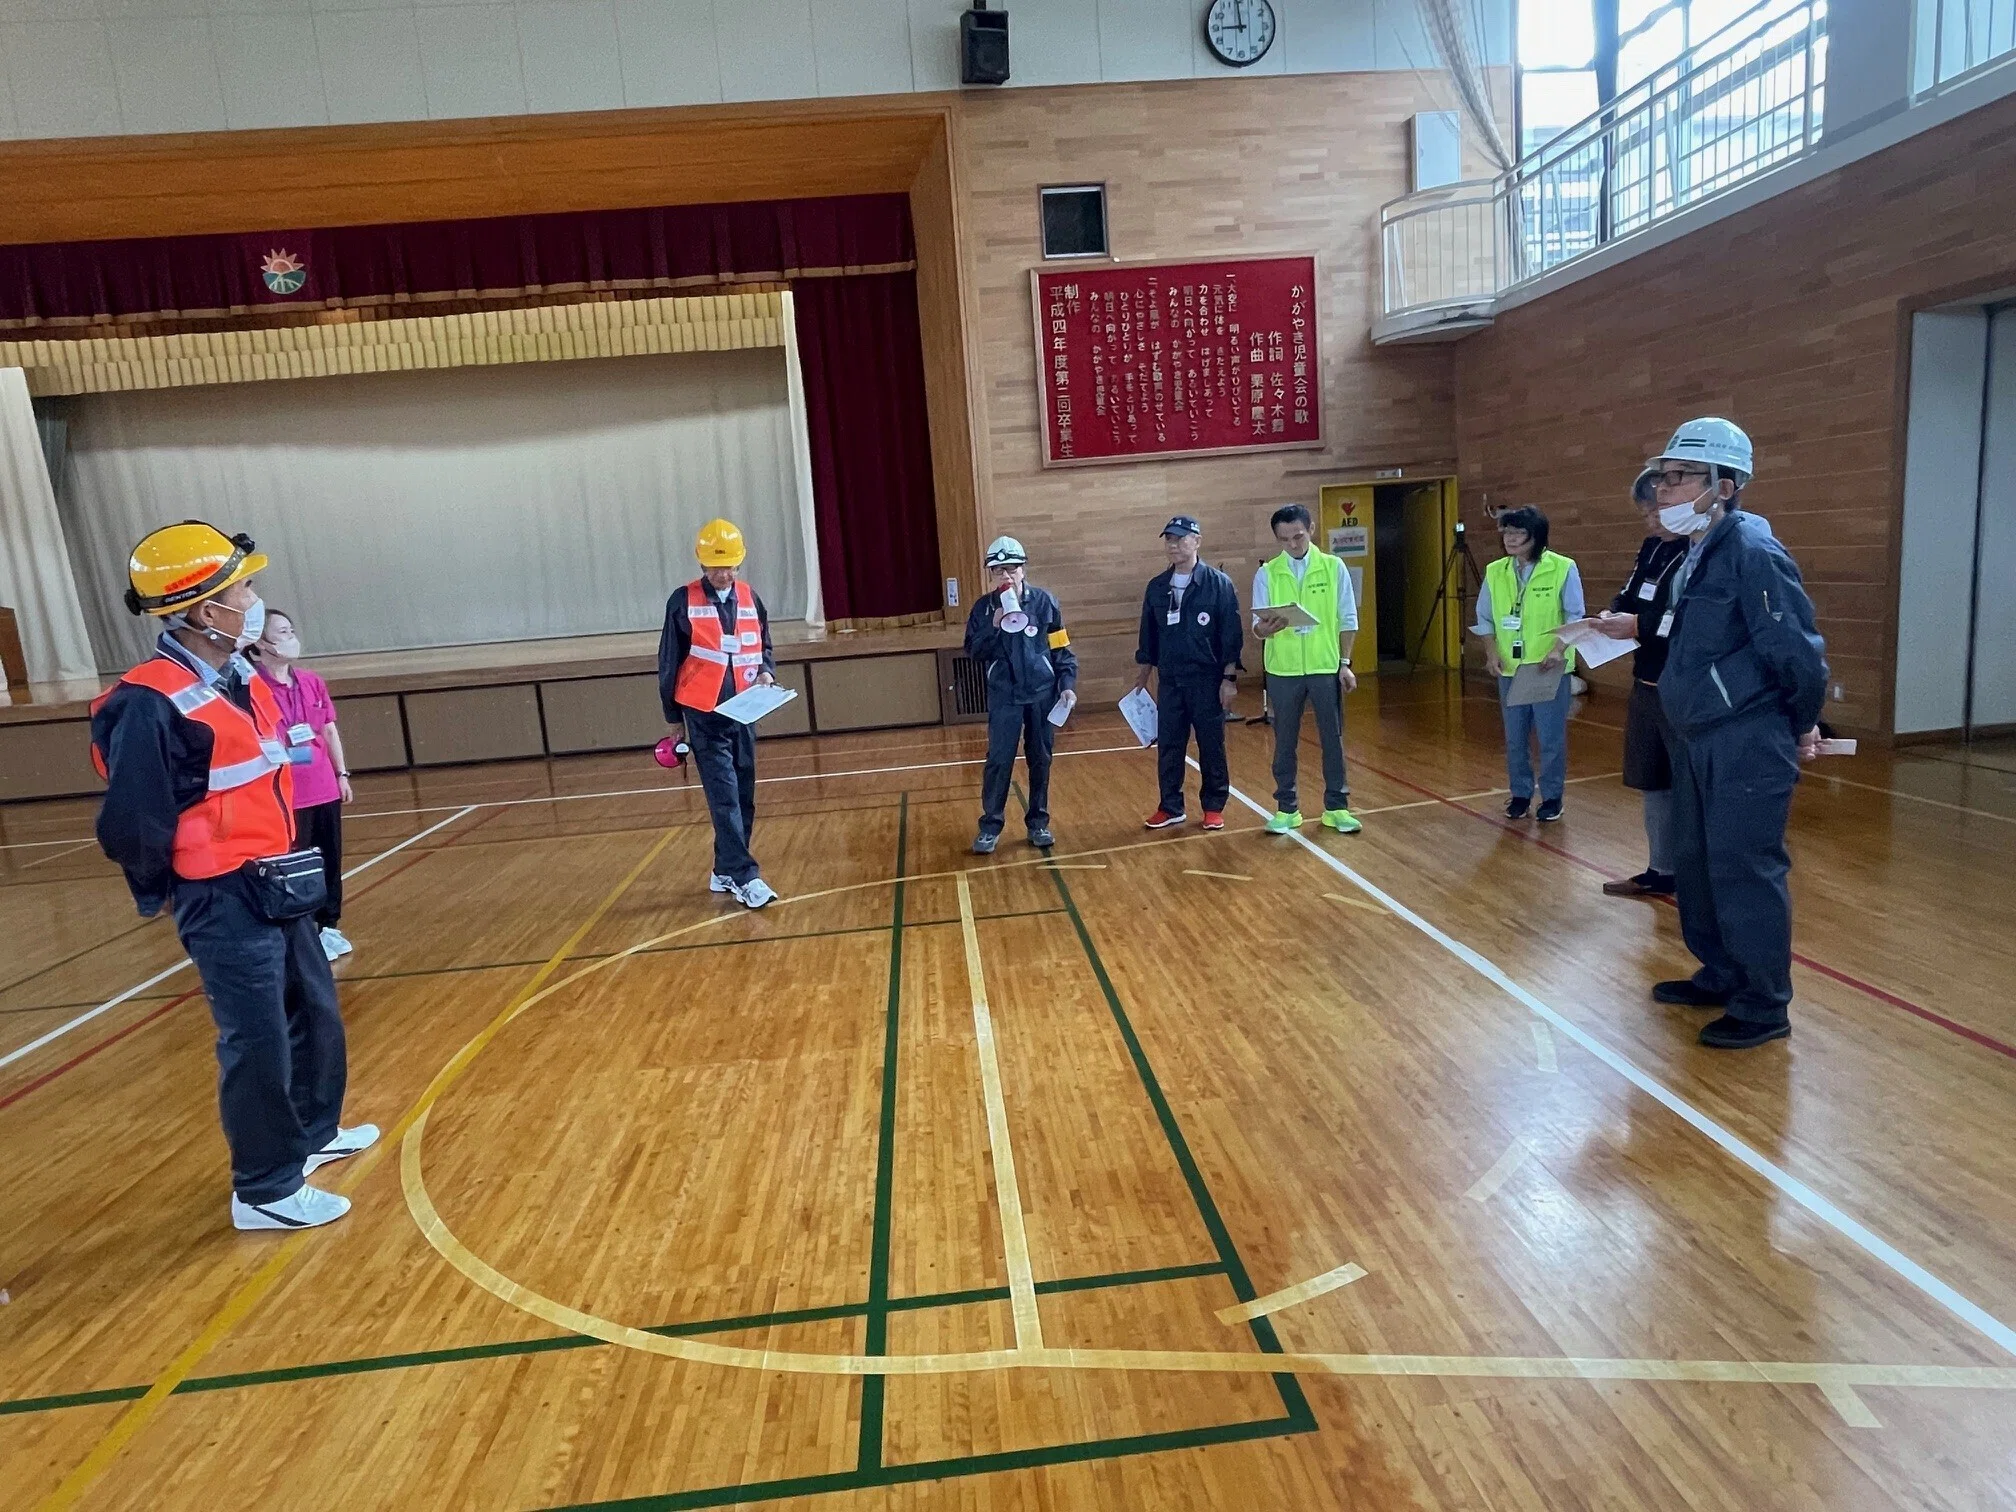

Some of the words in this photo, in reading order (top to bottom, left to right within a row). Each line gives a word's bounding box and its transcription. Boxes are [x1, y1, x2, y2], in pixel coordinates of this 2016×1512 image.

[1215, 12, 1224, 20] 10
[1226, 47, 1233, 55] 7
[1238, 50, 1246, 58] 6
[1064, 283, 1081, 318] 制作
[1198, 284, 1209, 336] 力を合わせ
[1249, 331, 1264, 363] 作曲
[1268, 330, 1284, 362] 作詞
[1291, 285, 1309, 424] かがやき児童会の歌
[1341, 517, 1358, 527] AED
